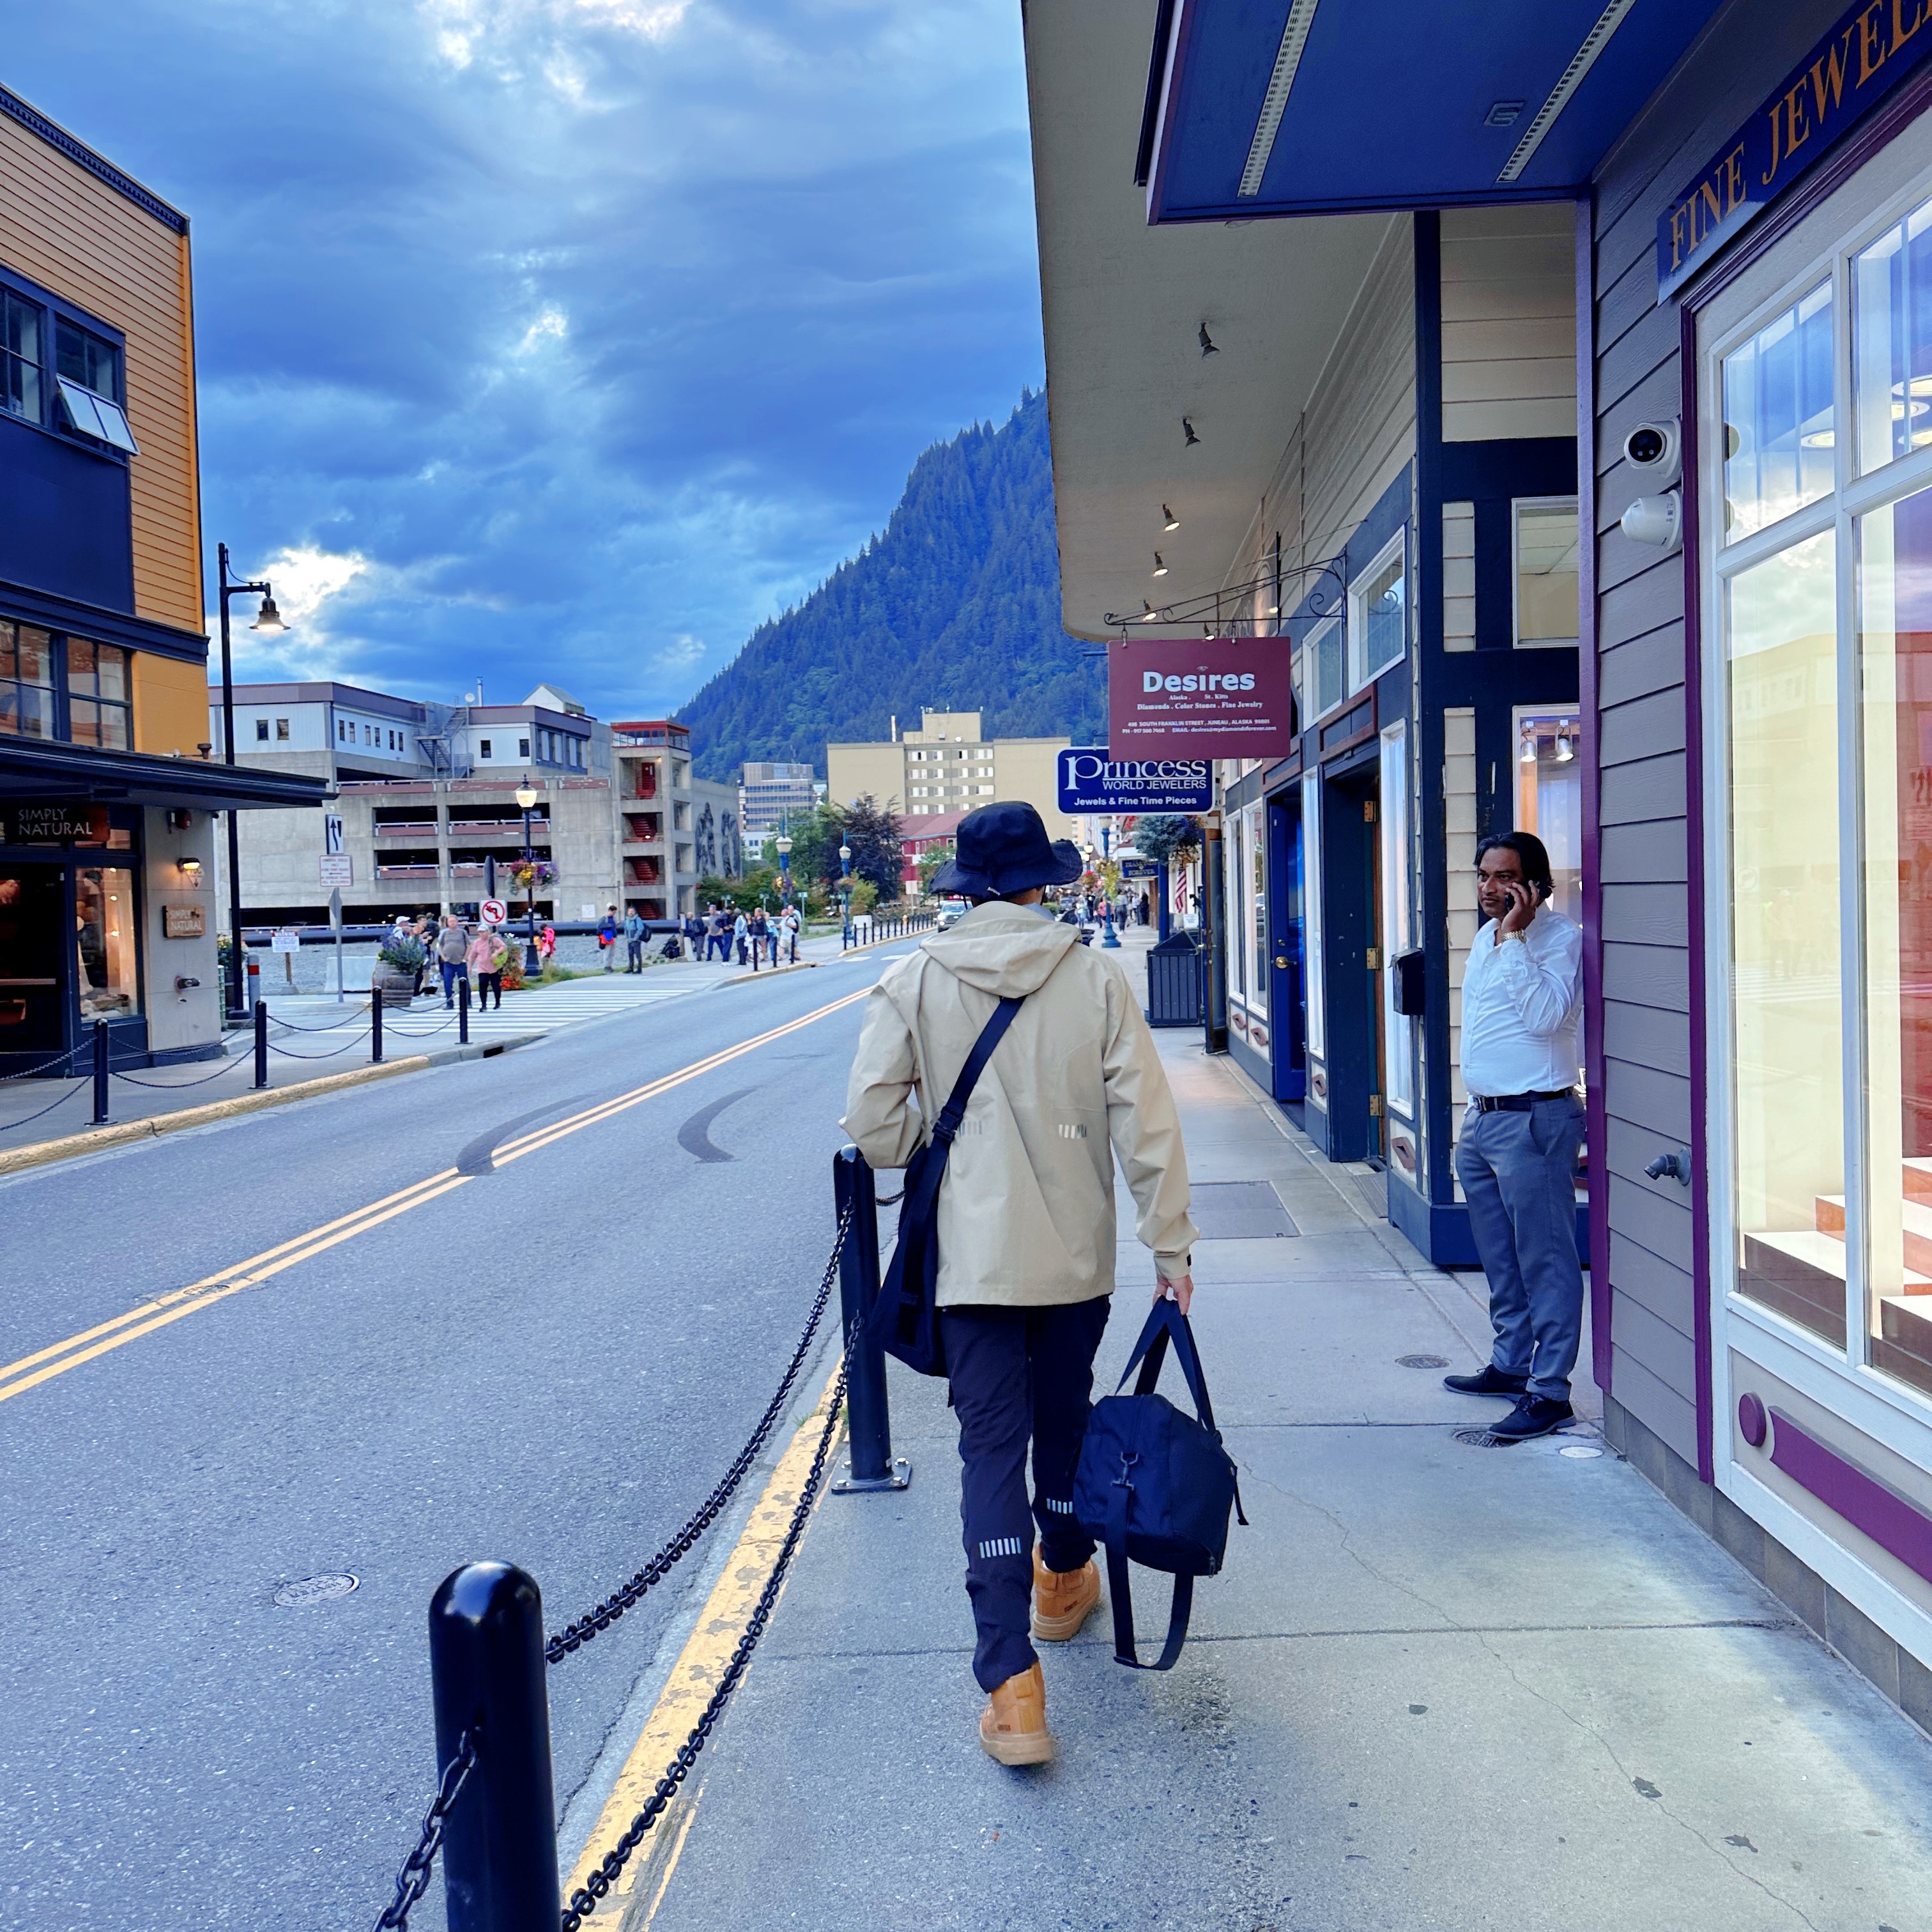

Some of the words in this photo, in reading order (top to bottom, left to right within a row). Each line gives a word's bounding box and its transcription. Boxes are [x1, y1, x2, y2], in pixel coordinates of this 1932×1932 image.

[1669, 141, 1746, 272] FINE
[1762, 0, 1932, 186] JEWEL
[1143, 671, 1255, 693] Desires
[1238, 701, 1262, 709] Jewelry
[1103, 780, 1144, 790] WORLD
[1147, 779, 1207, 790] JEWELERS
[1074, 797, 1107, 806] Jewels
[1108, 797, 1116, 805] &
[1118, 797, 1138, 805] Fine
[1140, 796, 1163, 805] Time
[1165, 796, 1197, 805] Pieces
[19, 808, 67, 821] SIMPLY
[19, 822, 93, 836] NATURAL
